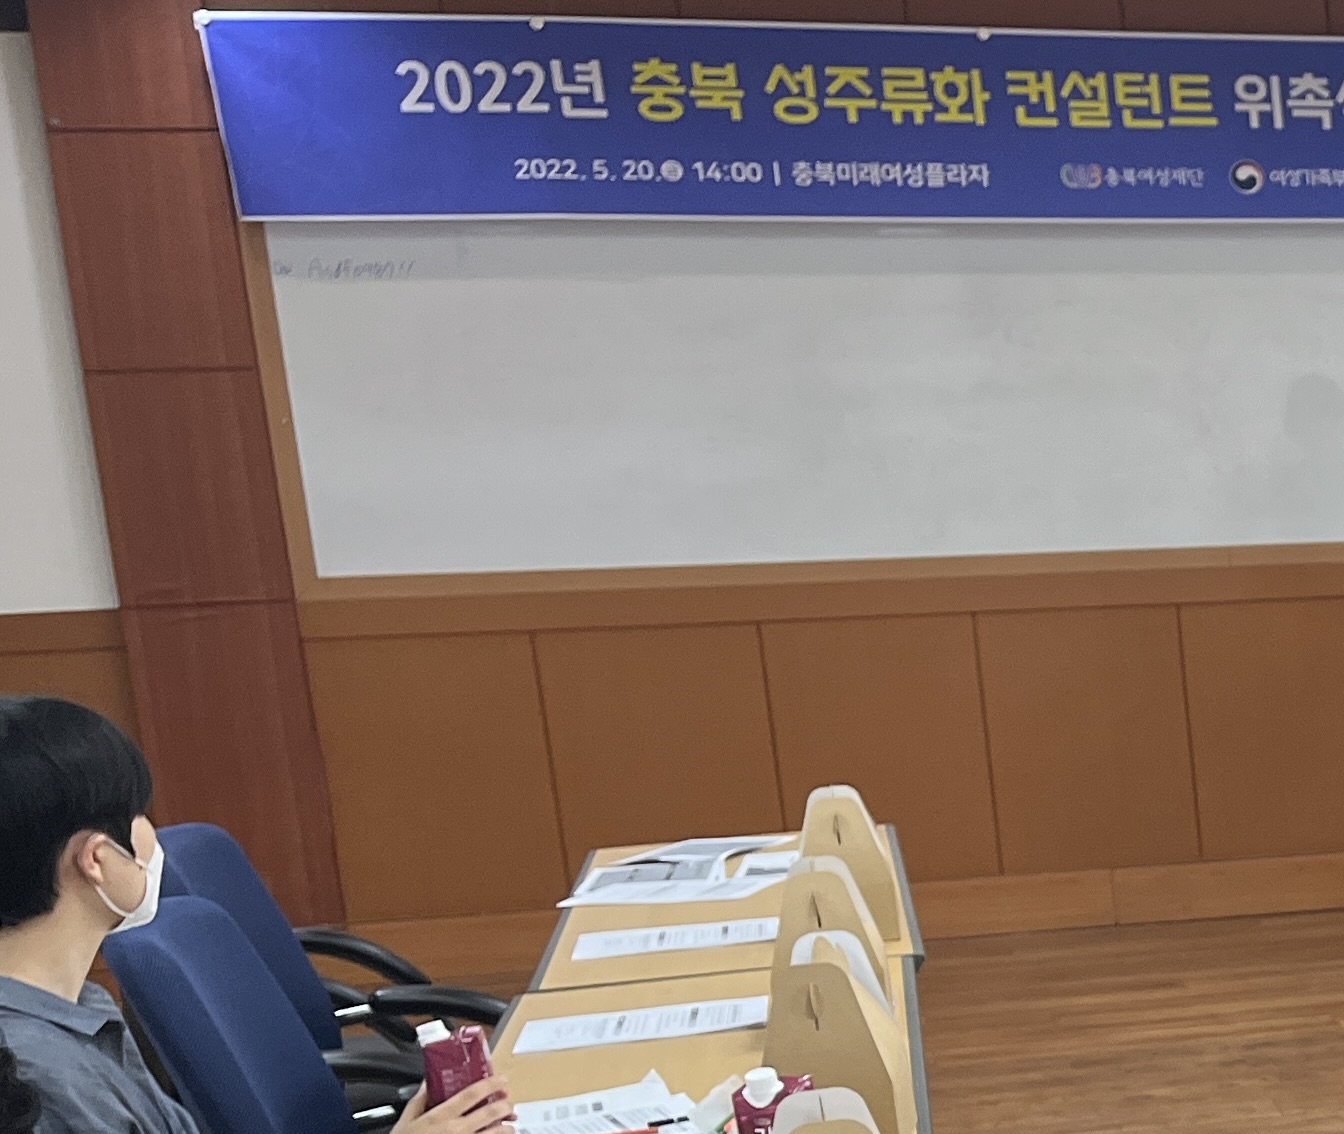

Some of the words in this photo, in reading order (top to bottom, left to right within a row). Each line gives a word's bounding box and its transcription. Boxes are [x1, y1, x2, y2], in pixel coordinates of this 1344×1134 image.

[396, 59, 607, 119] 2022년
[630, 58, 745, 122] 충북
[764, 63, 990, 126] 성주류화
[1005, 69, 1218, 129] 컨설턴트
[692, 160, 762, 183] 14:00
[792, 160, 989, 188] 충북미래여성플라자
